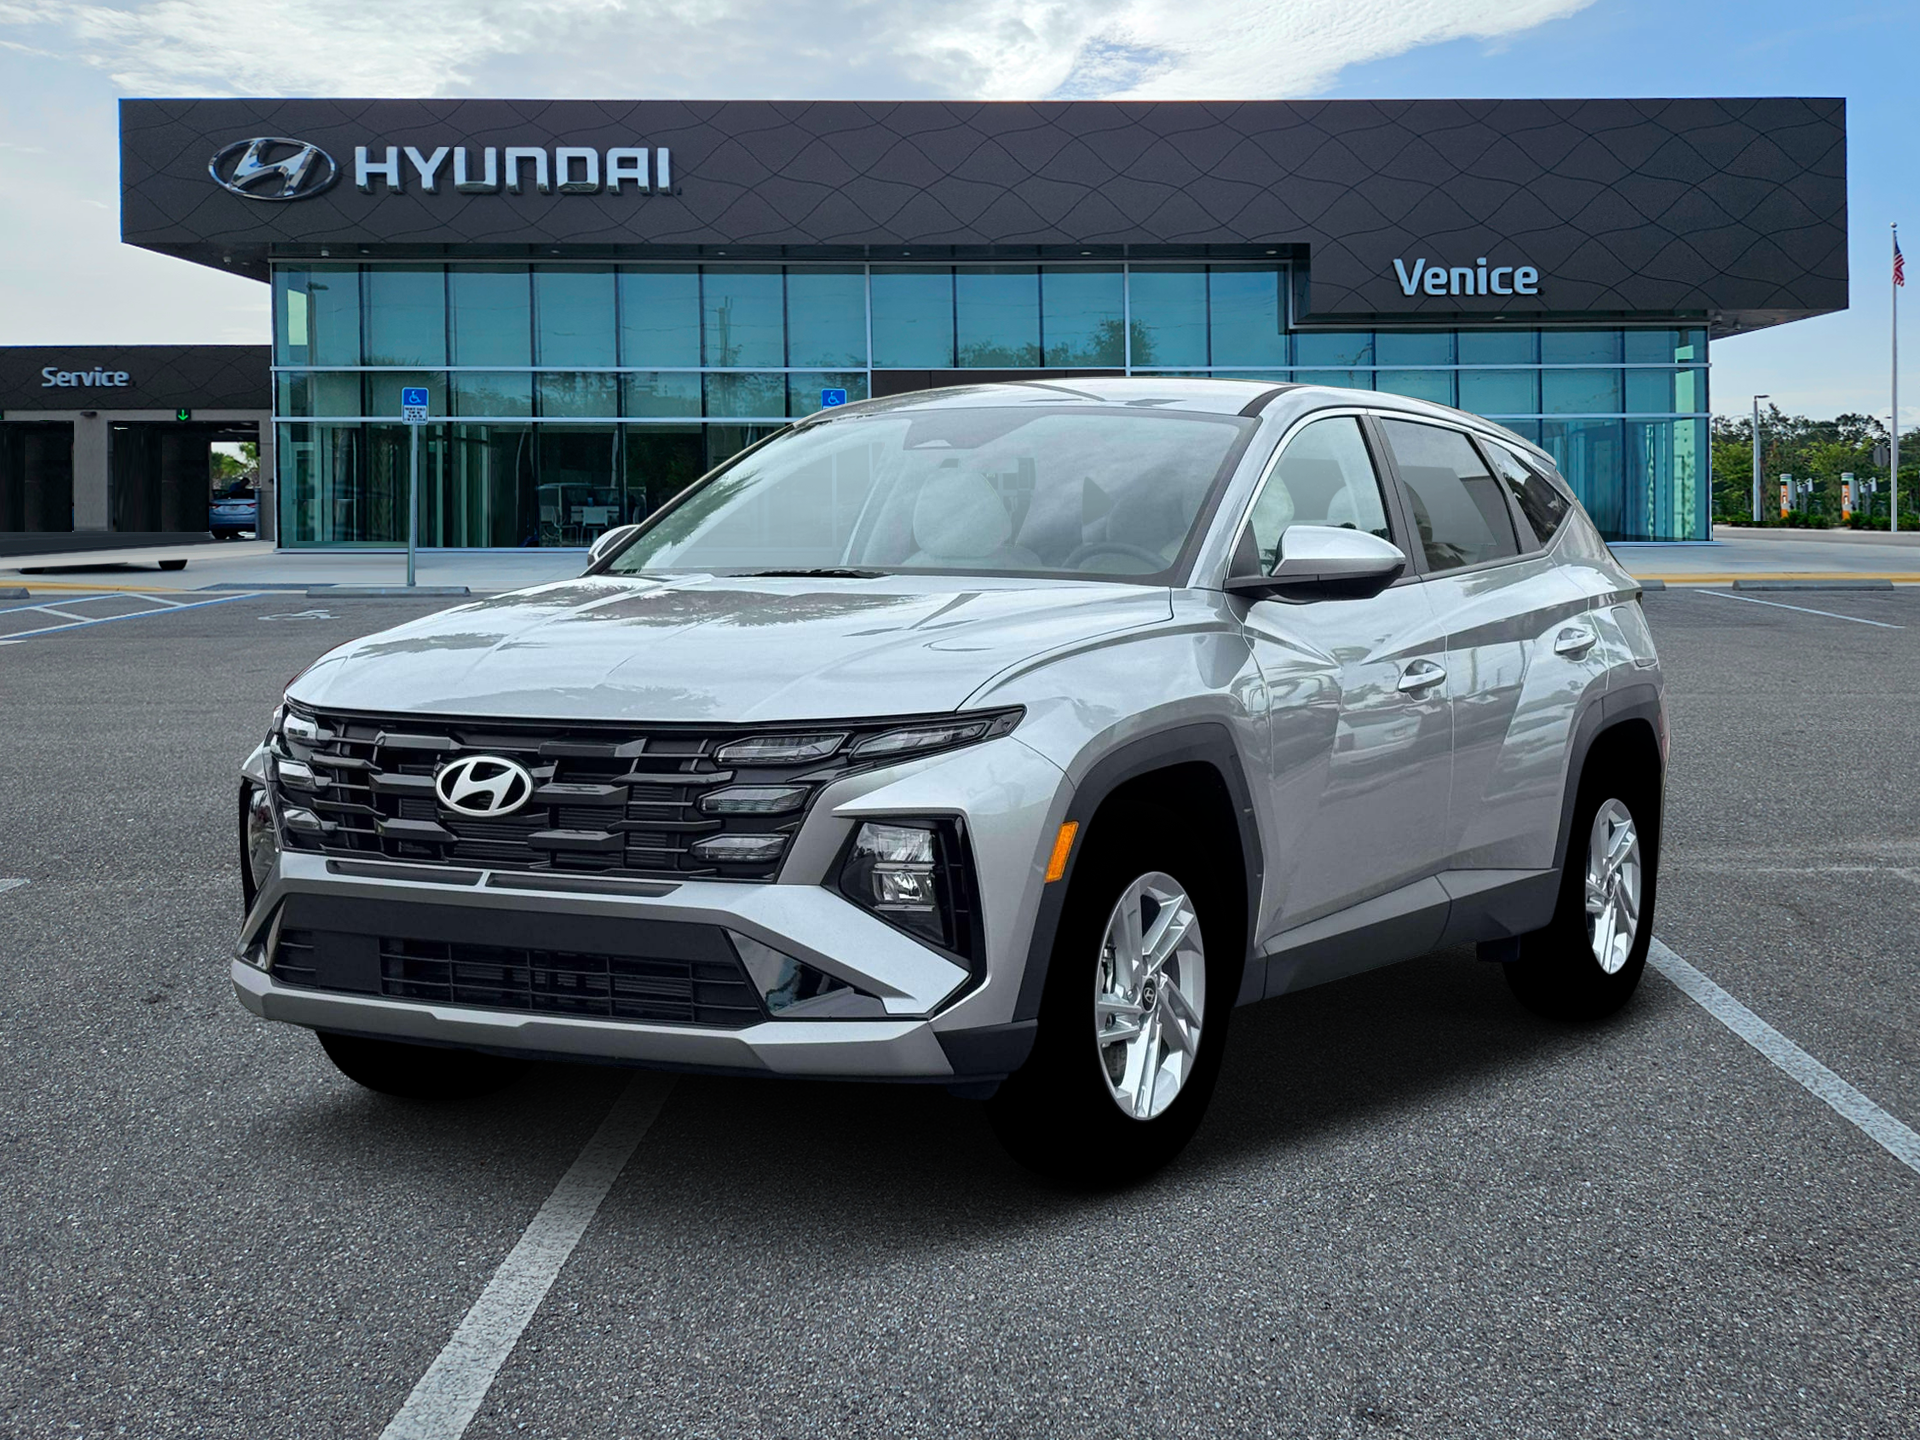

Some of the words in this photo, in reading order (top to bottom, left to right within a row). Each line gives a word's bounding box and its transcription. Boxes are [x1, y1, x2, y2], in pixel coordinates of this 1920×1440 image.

[354, 146, 672, 194] HYUNDAI
[1393, 257, 1539, 296] Venice
[41, 366, 130, 387] Service
